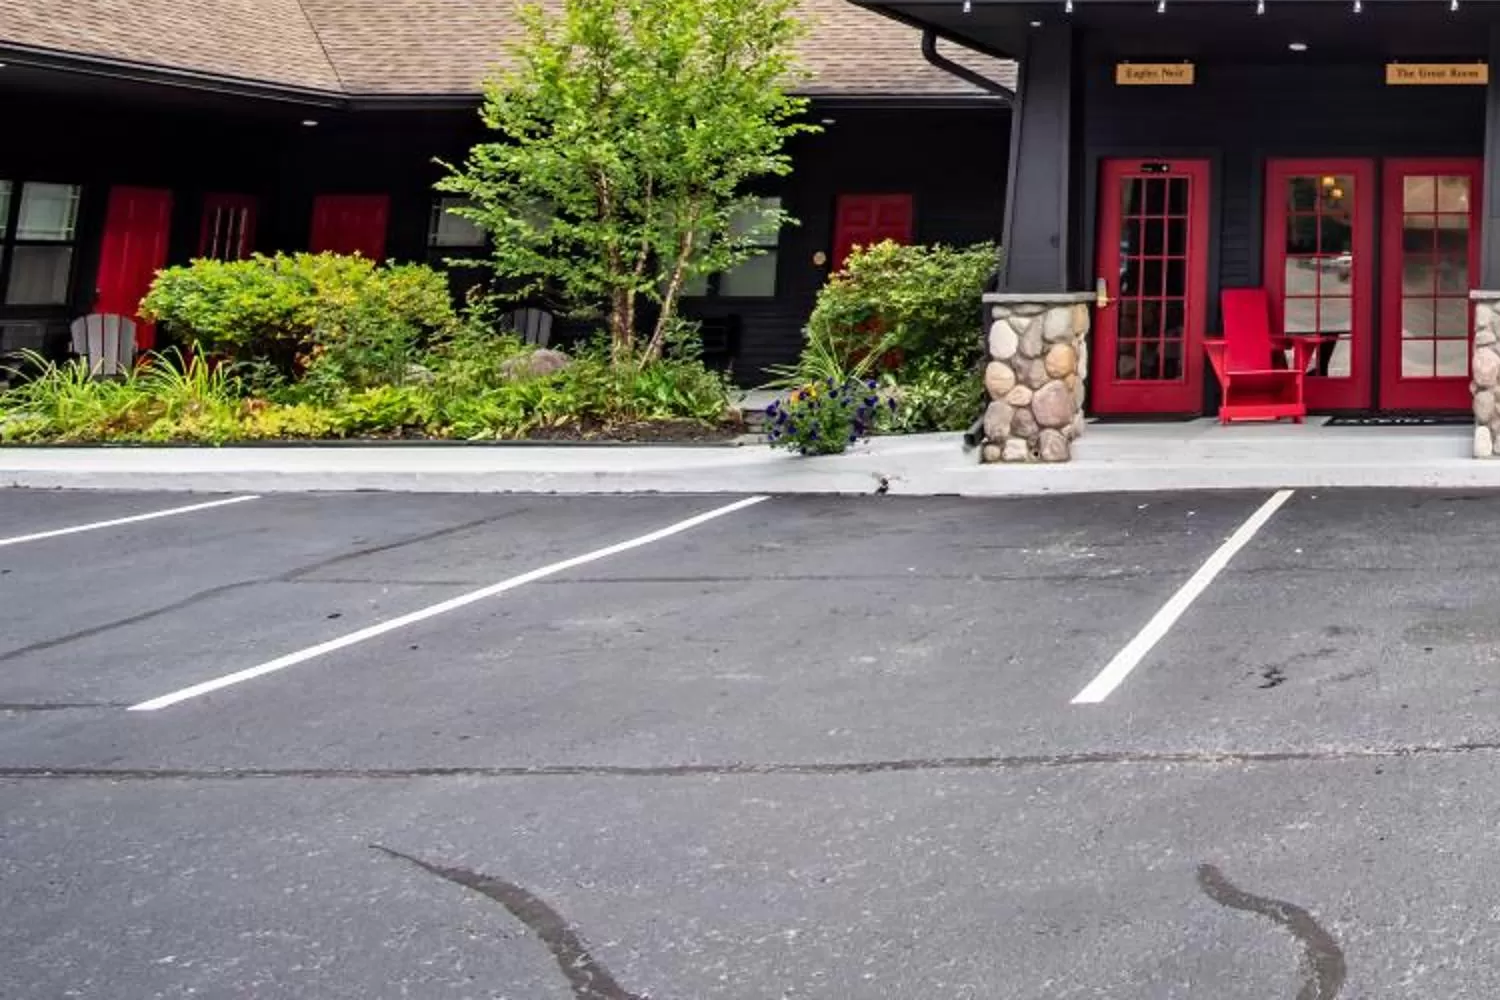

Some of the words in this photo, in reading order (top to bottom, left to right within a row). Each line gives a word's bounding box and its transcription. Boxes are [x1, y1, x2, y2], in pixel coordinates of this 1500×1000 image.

[1395, 67, 1414, 78] The
[1418, 67, 1445, 78] Great
[1448, 67, 1479, 78] Room
